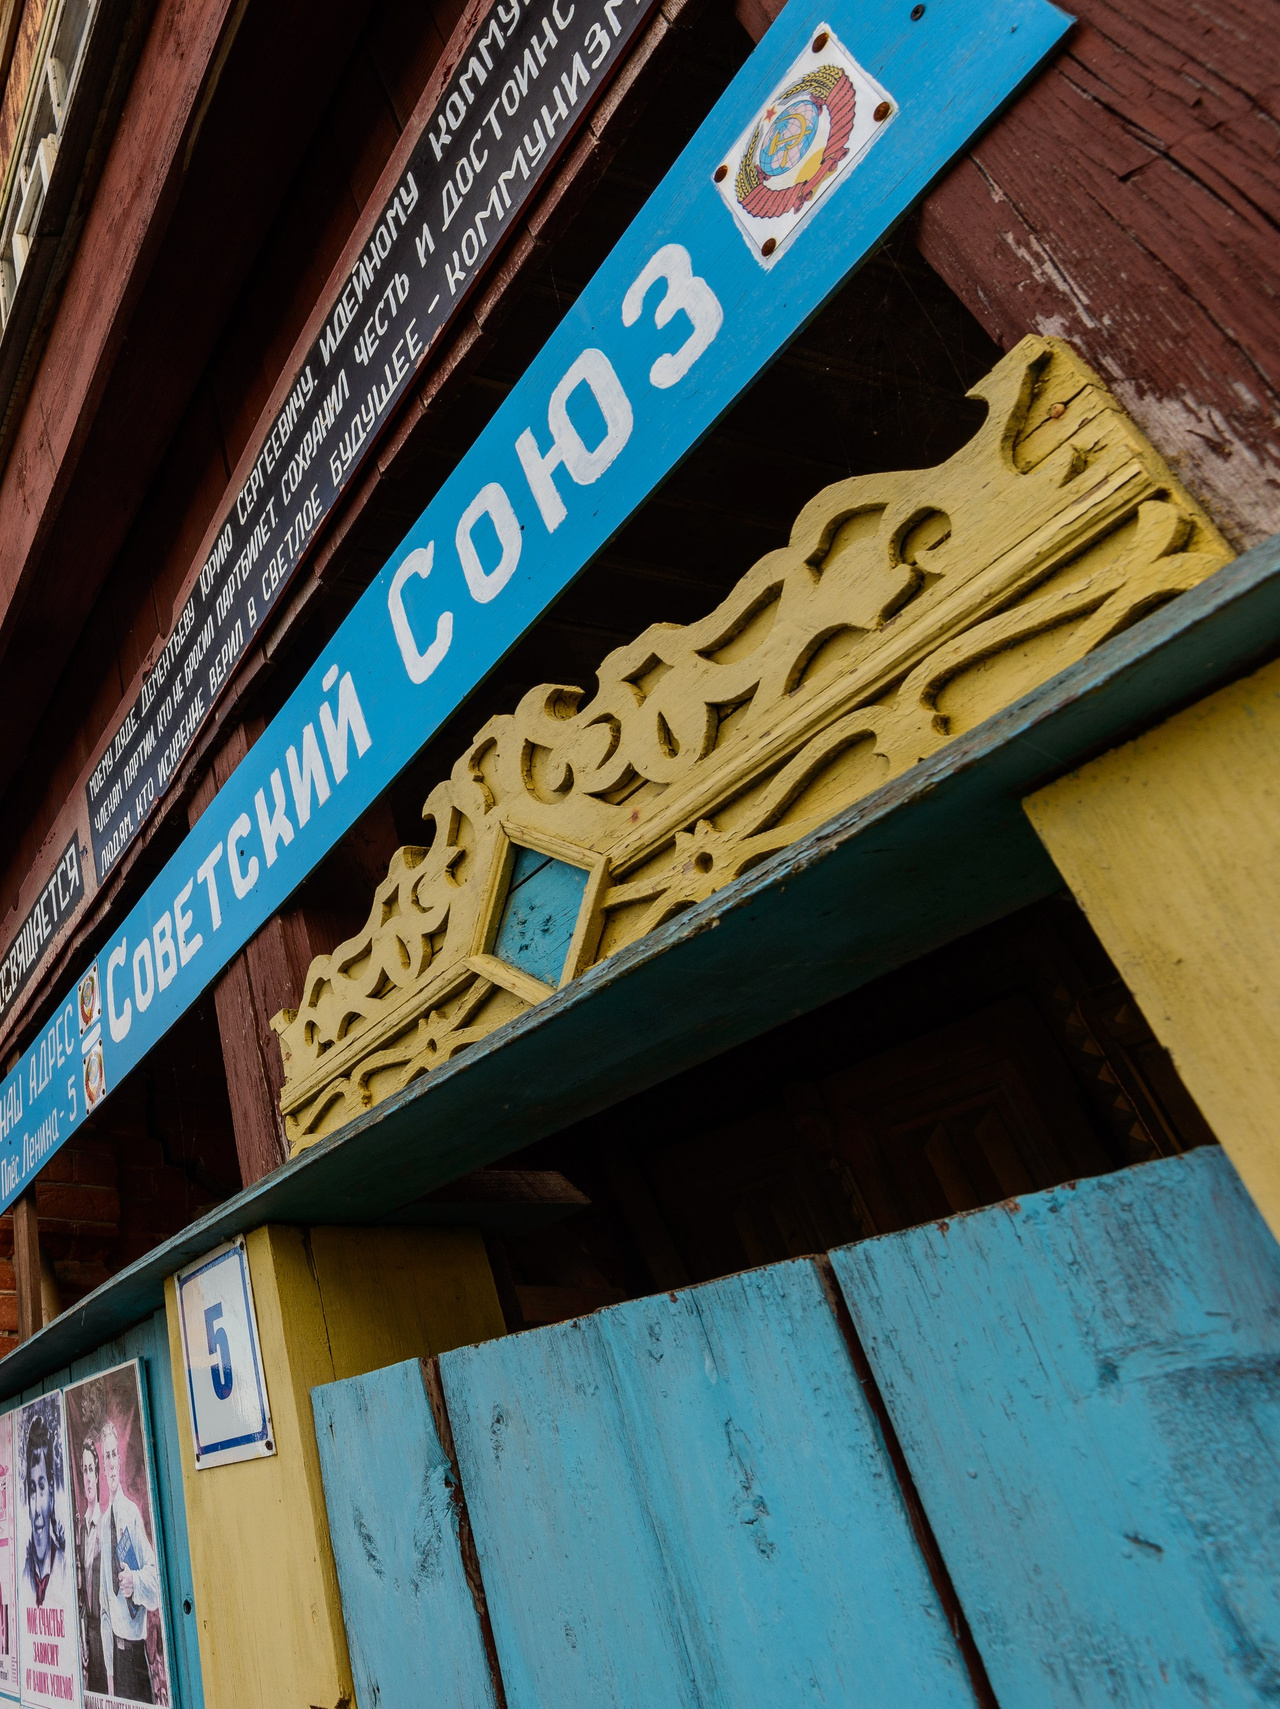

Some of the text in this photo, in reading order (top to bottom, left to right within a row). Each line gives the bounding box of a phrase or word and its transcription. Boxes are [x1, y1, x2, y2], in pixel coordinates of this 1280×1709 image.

[89, 746, 114, 801] МОЕМУ
[141, 597, 196, 717] ДЕМЕНТЬЕВУ
[199, 523, 233, 601] ЮРИЮ
[319, 172, 418, 367] ИДЕЙНОМУ
[429, 0, 531, 161] КОММУ
[94, 779, 123, 833] ЧЛЕНАМ
[157, 696, 173, 738] КТО
[173, 673, 185, 704] НЕ
[184, 614, 215, 687] БРОСИЛ
[281, 368, 350, 506] СОХРАНИЛ
[353, 273, 410, 368] ЧЕСТЬ
[415, 222, 436, 268] И
[106, 243, 724, 1044] СОВЕТСКИЙ СОЮЗ
[136, 777, 155, 820] КТО
[157, 687, 205, 787] ИСКРЕННЕ
[209, 618, 244, 696] ВЕРИЛ
[247, 596, 258, 629] В
[261, 484, 323, 602] СВЕТЛОЕ
[330, 317, 423, 487] БУДУЩЕЕ
[0, 1002, 75, 1142] НАШ АДРЕС
[22, 1107, 60, 1178] Ленина
[67, 1074, 78, 1122] 5
[204, 1301, 234, 1401] 5
[39, 1608, 65, 1638] СЧАСТЬЕ
